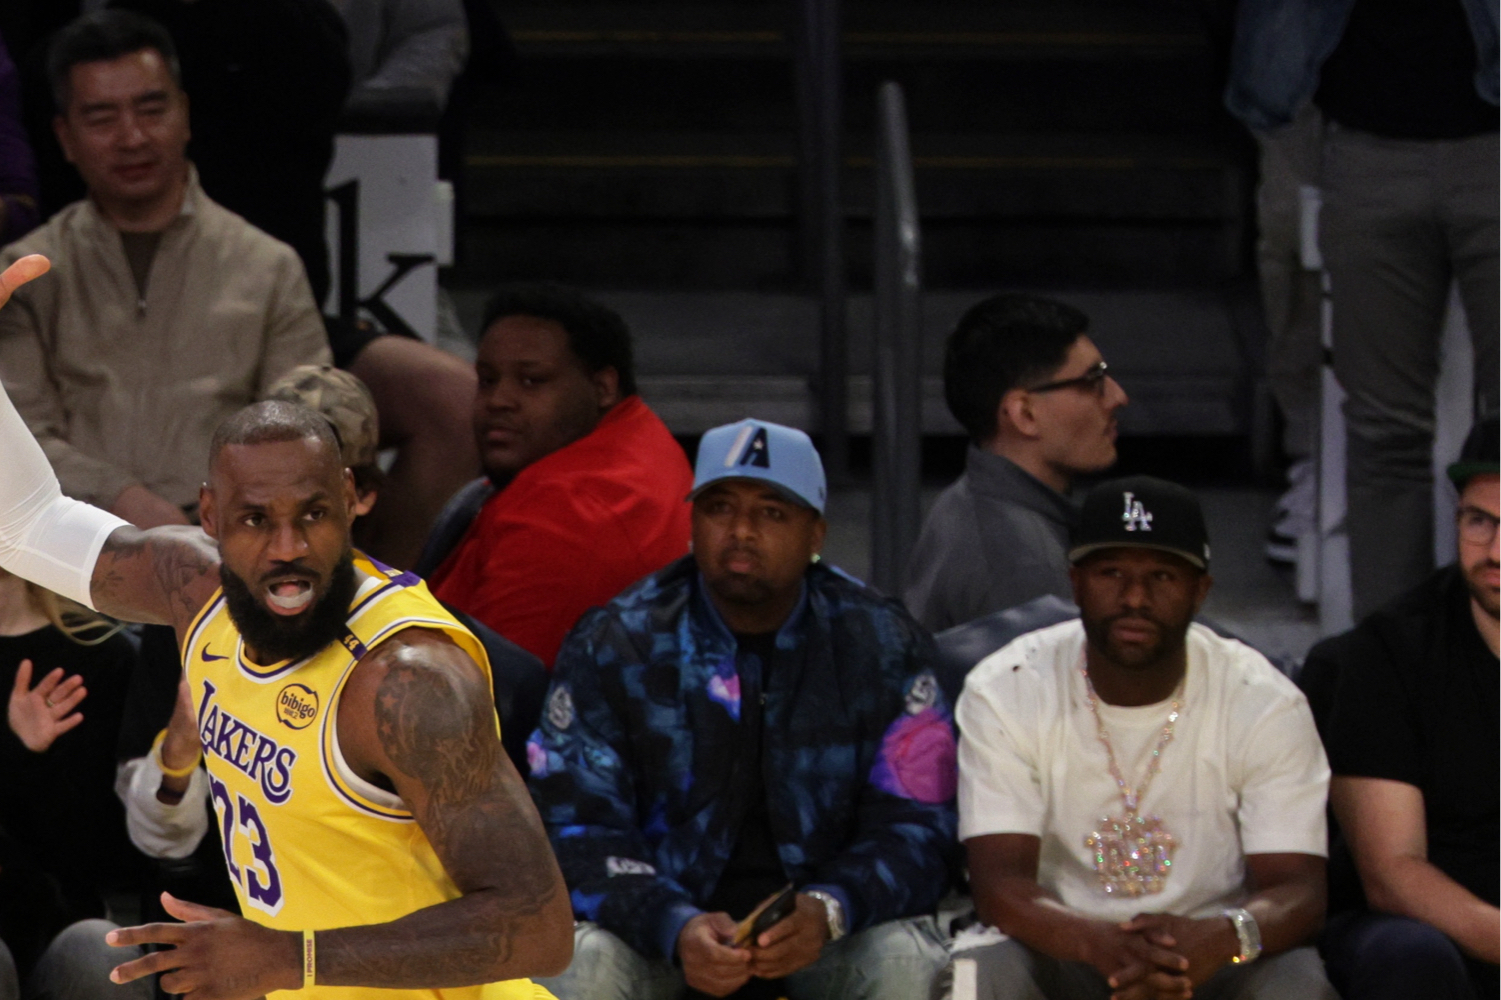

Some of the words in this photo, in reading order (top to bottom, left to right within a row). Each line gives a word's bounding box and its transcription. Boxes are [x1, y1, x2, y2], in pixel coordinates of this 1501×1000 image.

[1122, 491, 1153, 531] LA
[280, 690, 316, 719] bibigo
[208, 770, 285, 911] 23
